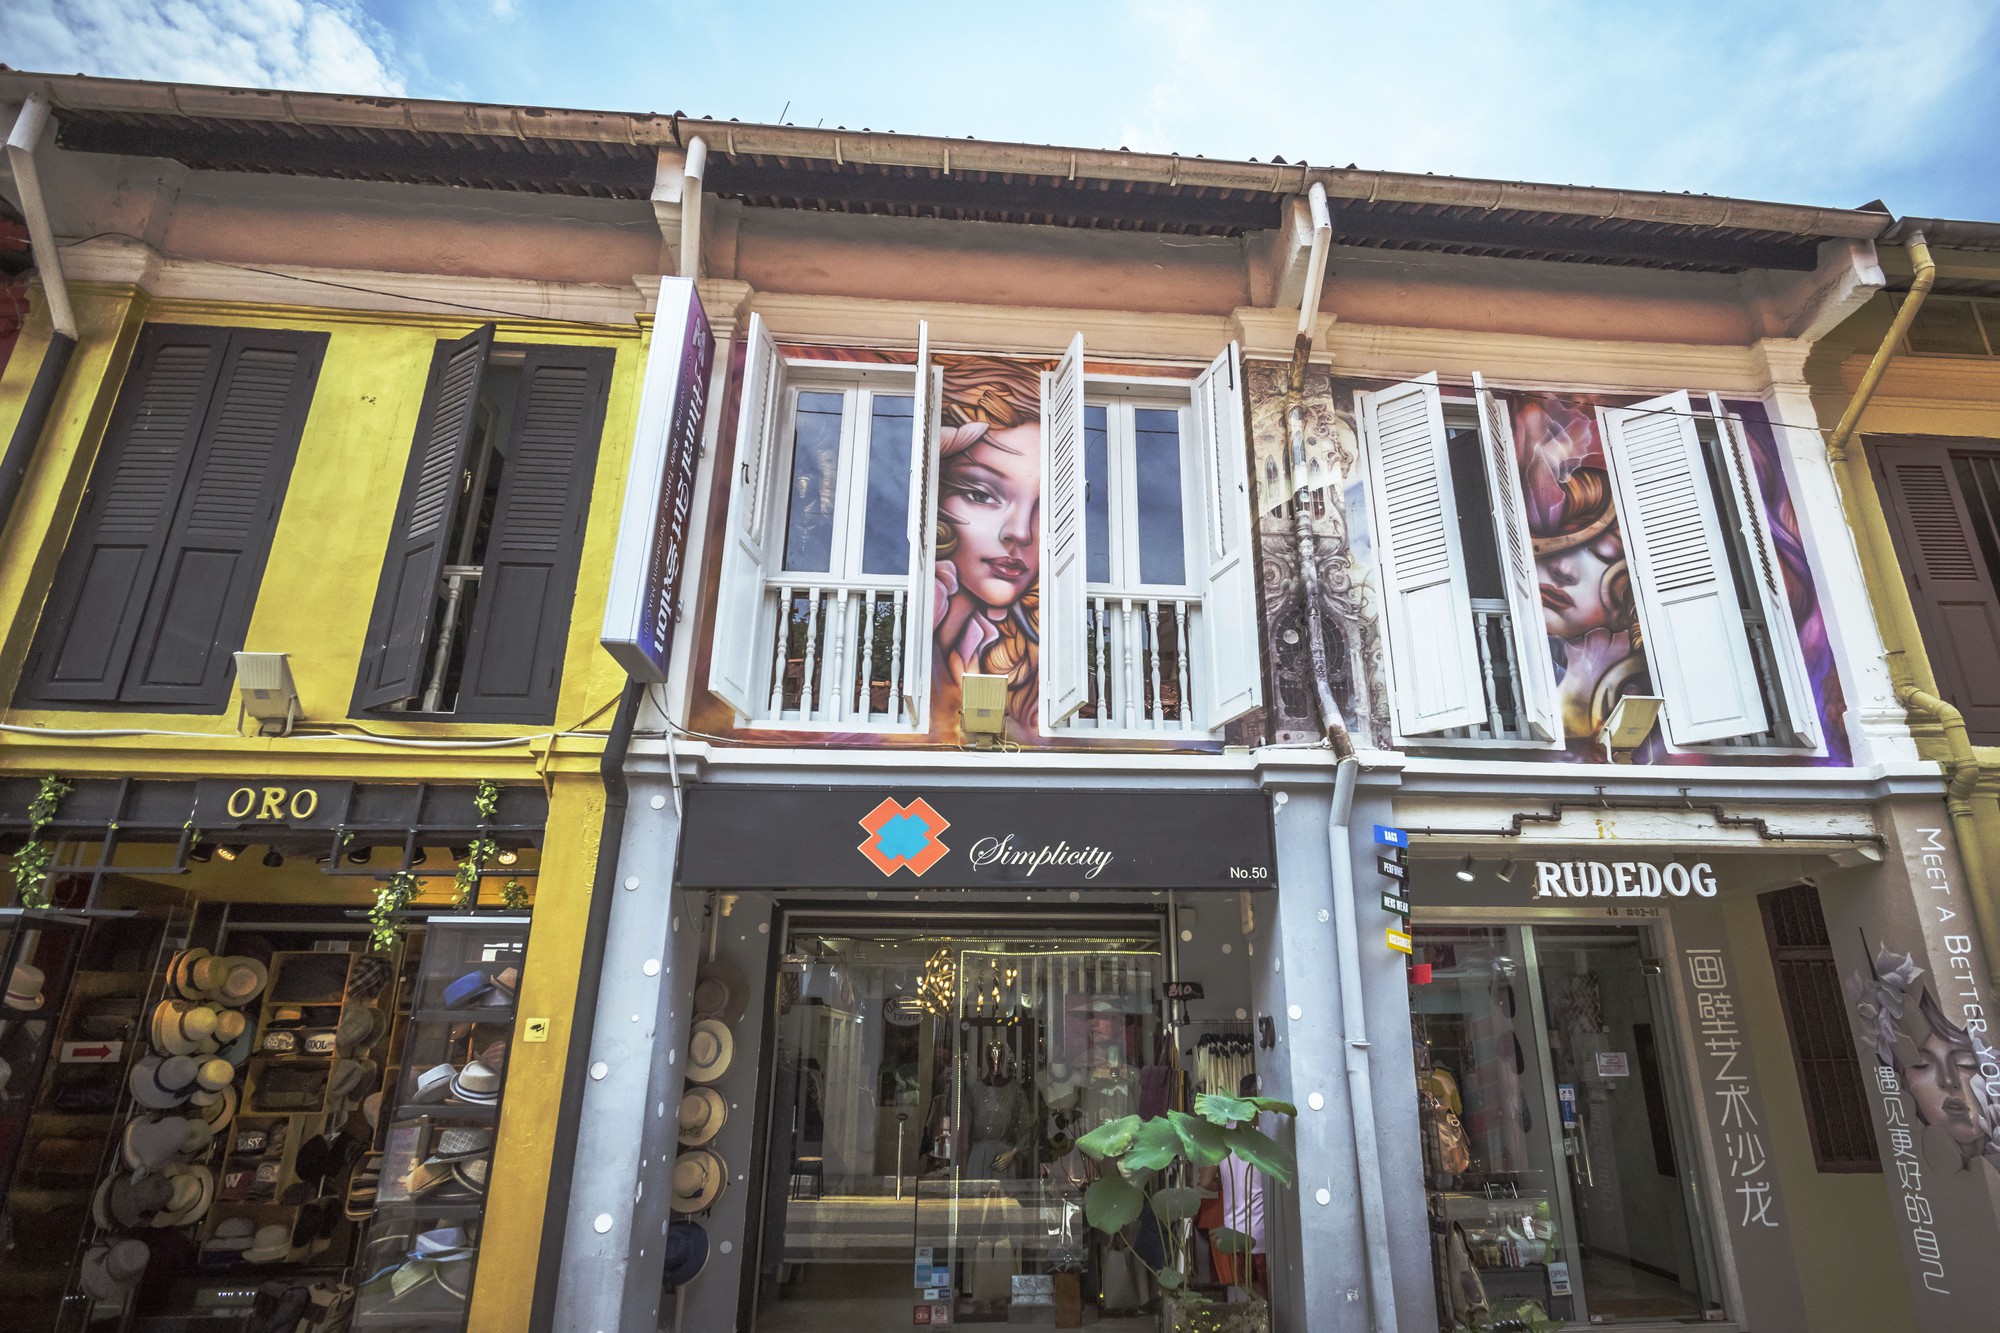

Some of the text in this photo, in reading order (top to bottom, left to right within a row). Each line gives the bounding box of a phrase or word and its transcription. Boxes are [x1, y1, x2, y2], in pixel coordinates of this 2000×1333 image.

[654, 358, 704, 653] Mural Art Salon
[664, 470, 675, 509] Tattoo
[651, 516, 667, 583] Permanent
[227, 787, 318, 819] ORO
[1384, 830, 1398, 843] BAGS
[969, 833, 1114, 880] Simplicity
[1230, 866, 1267, 879] No.50
[1383, 861, 1404, 878] PERFUME
[1535, 861, 1718, 898] RUDEDOG
[1606, 907, 1660, 917] 48 #02-01
[1936, 906, 1956, 922] A
[1686, 949, 1779, 1227] 画壁艺术沙龙
[1874, 1066, 1950, 1295] 遇见更好的自己
[1550, 1269, 1568, 1278] OPEN
